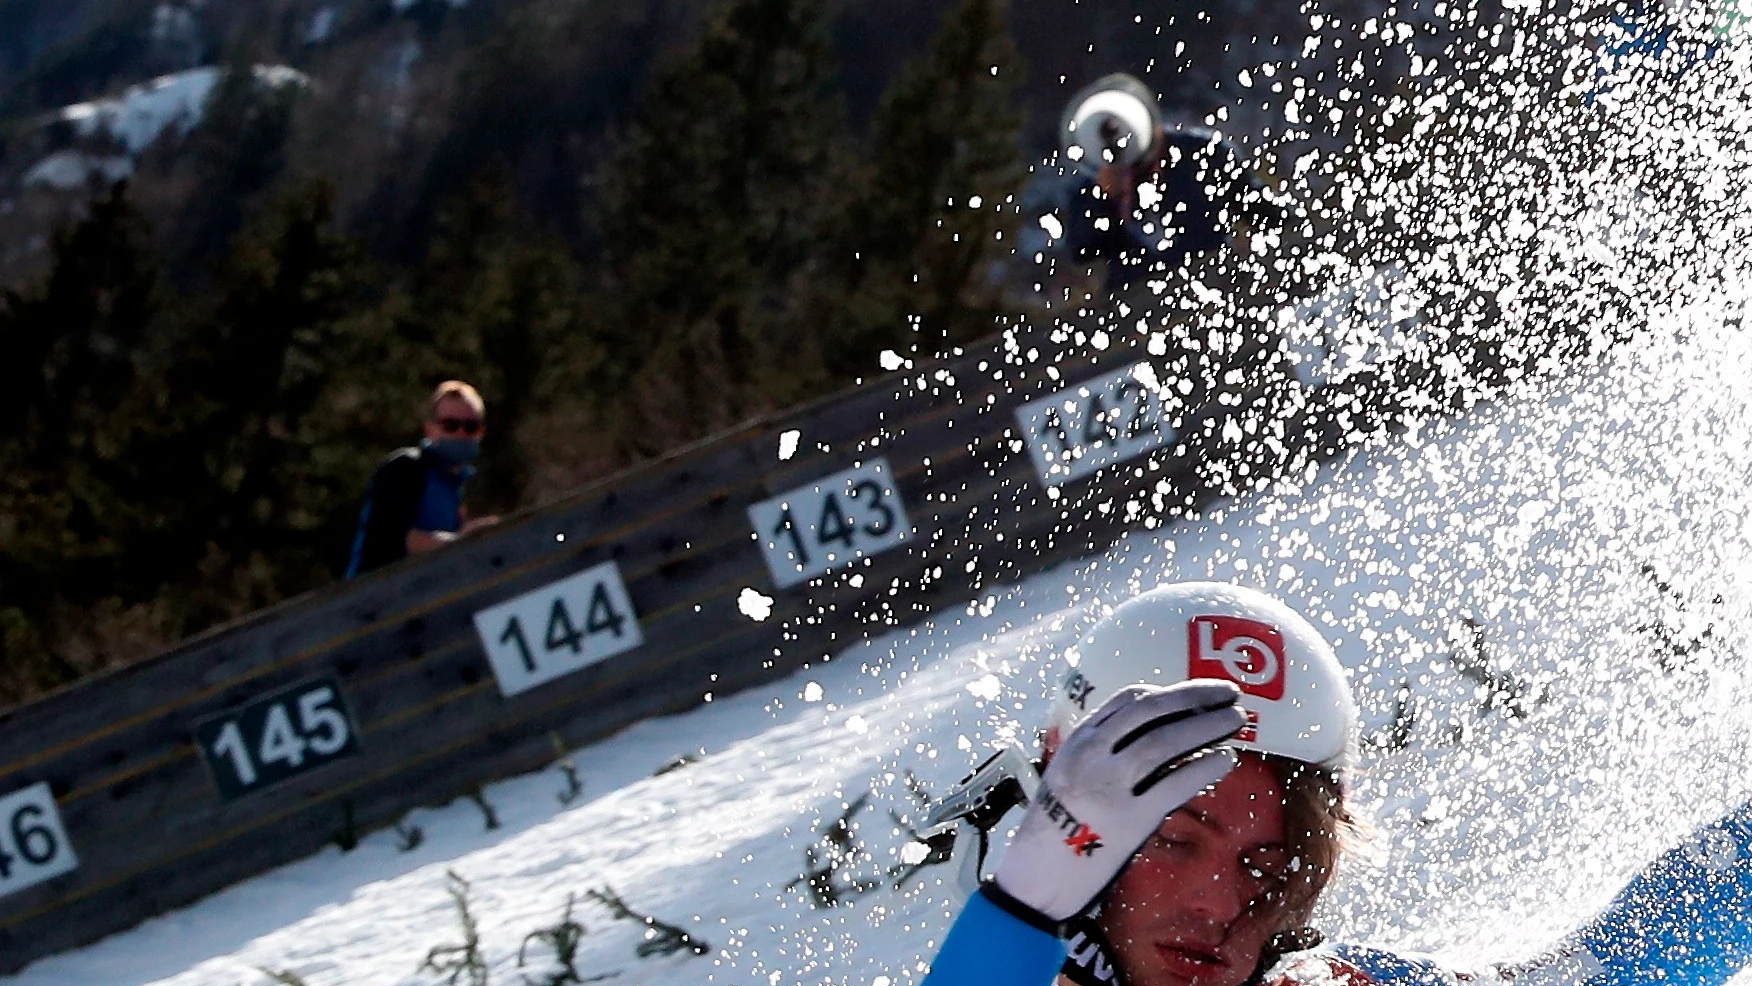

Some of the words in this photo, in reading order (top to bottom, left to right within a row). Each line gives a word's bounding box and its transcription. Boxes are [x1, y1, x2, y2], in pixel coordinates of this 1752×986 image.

[1039, 381, 1159, 462] 142
[774, 479, 895, 564] 143
[500, 581, 626, 673] 144
[212, 686, 349, 786] 145
